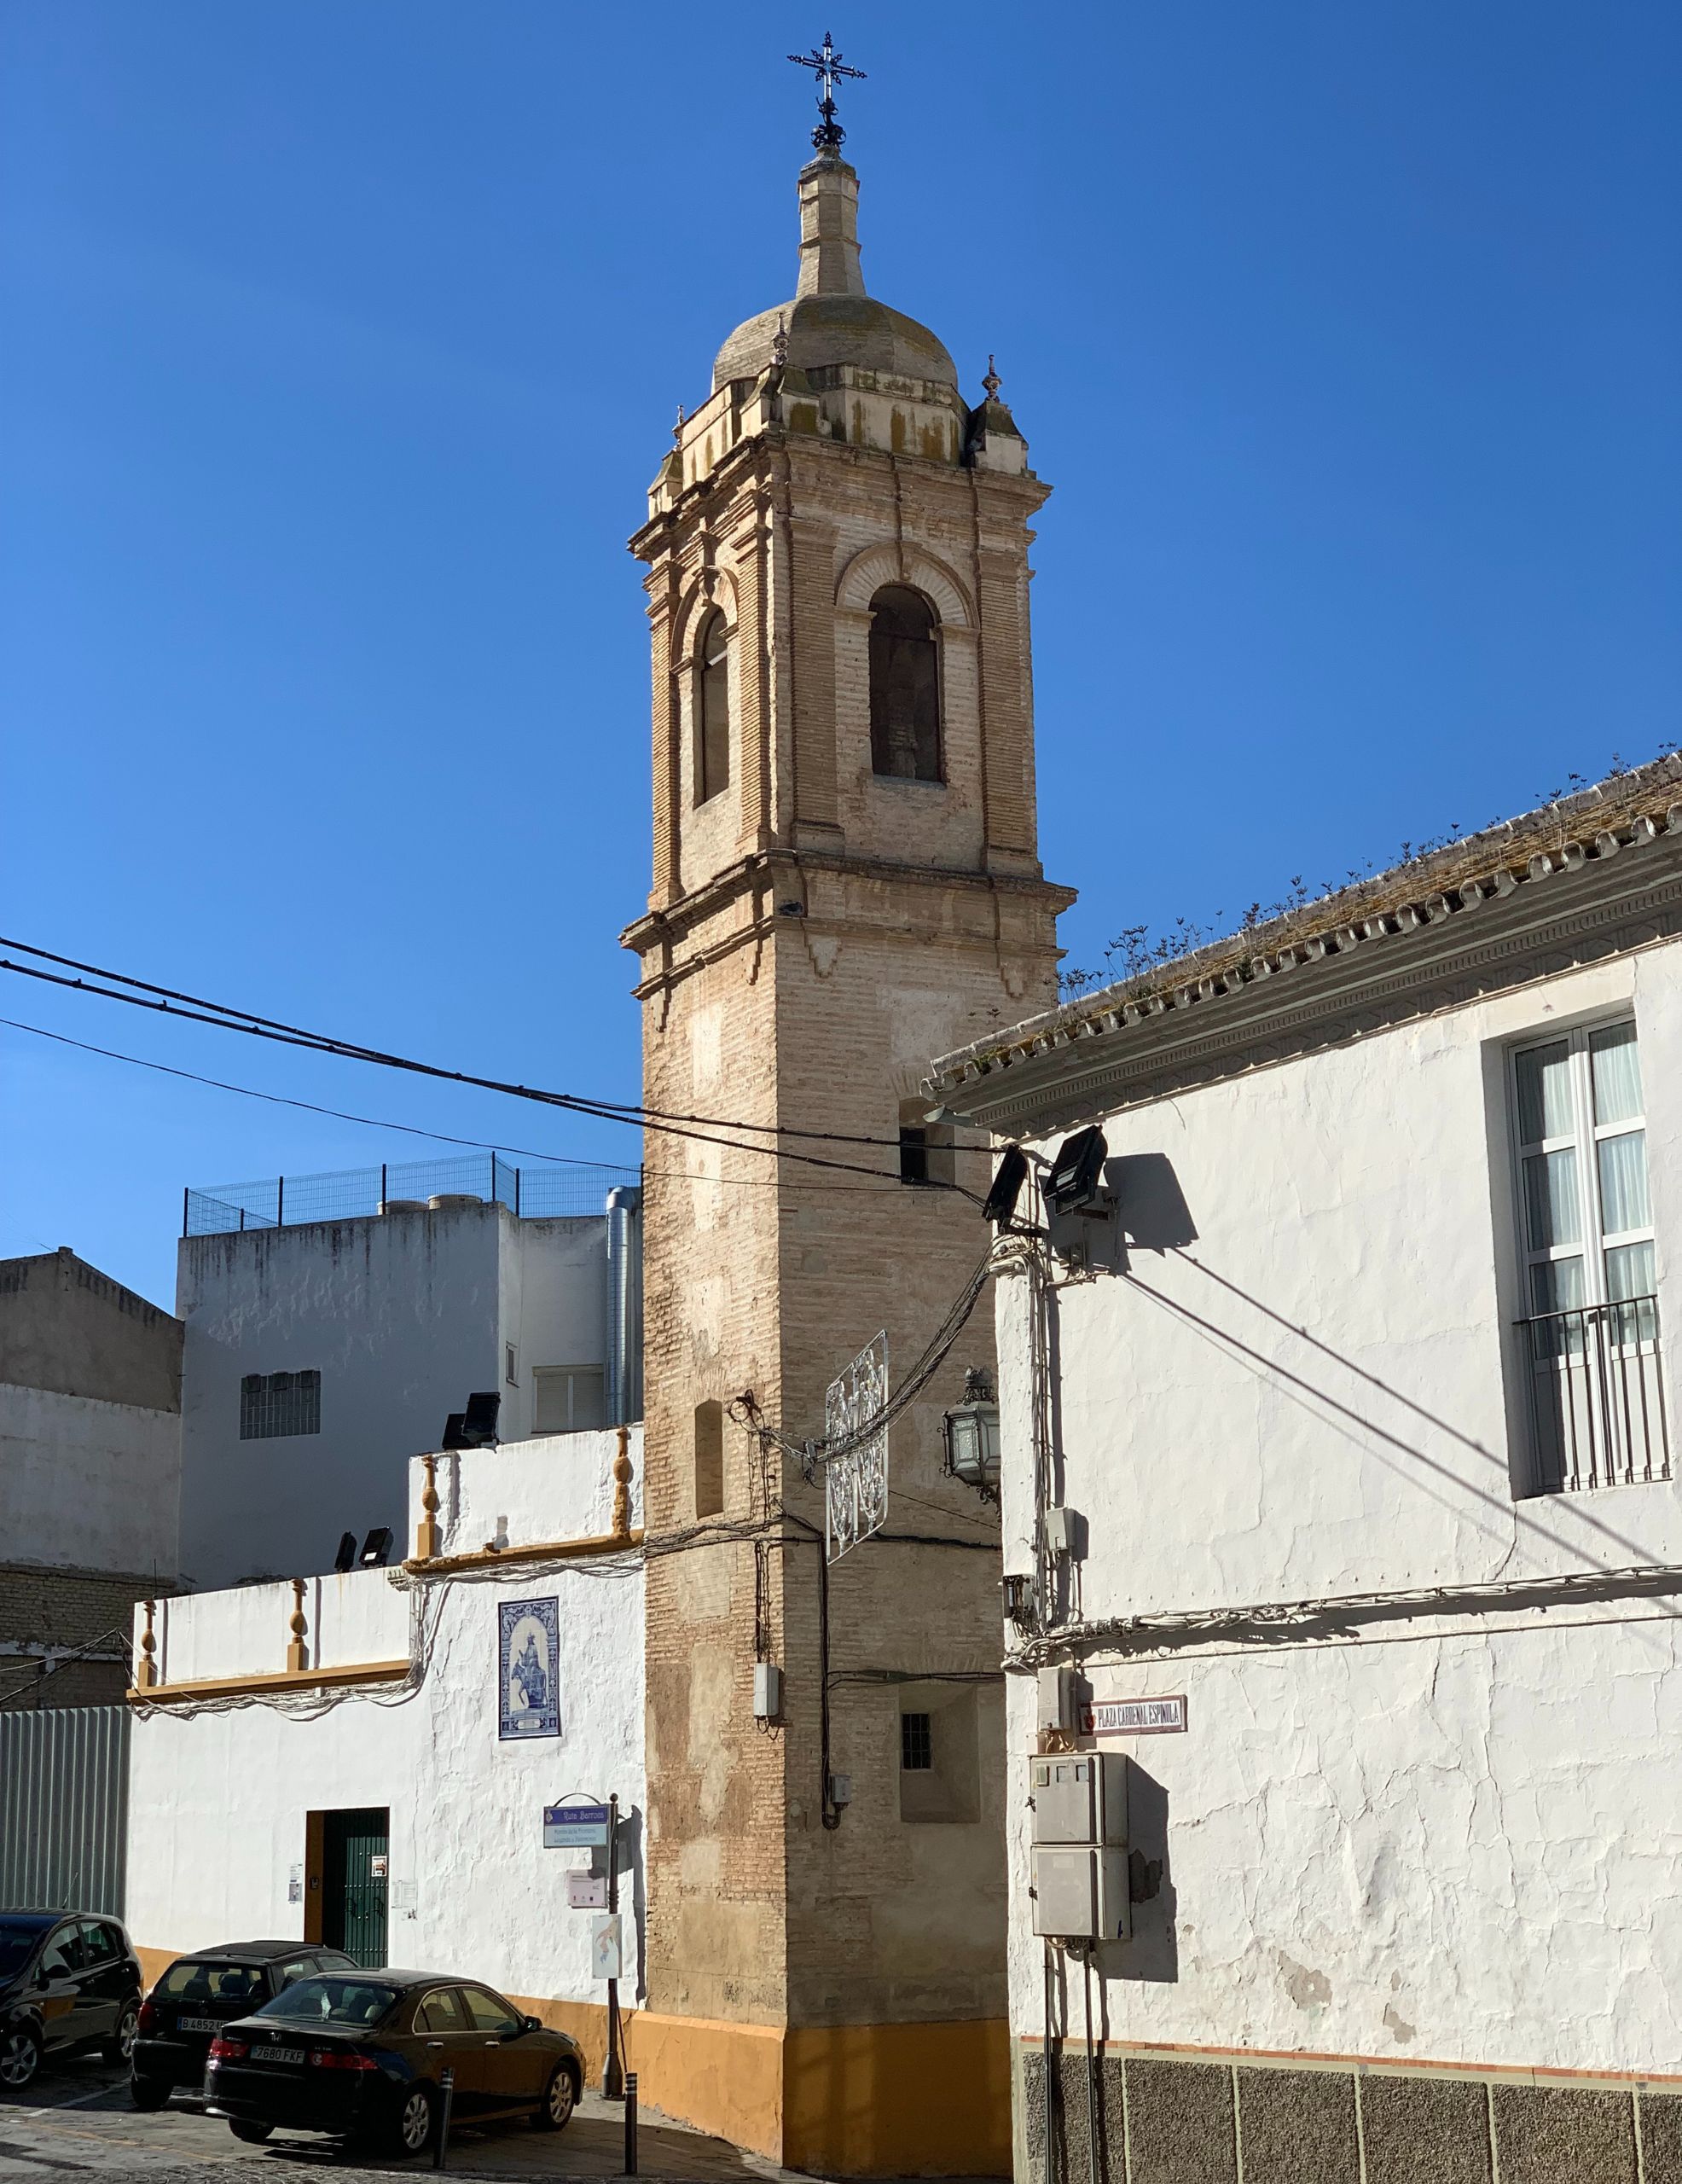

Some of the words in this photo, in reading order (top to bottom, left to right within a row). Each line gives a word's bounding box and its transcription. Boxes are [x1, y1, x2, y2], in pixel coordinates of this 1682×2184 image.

[1098, 1707, 1117, 1728] PLAZA
[1117, 1705, 1148, 1726] CARDENAL
[563, 1811, 577, 1821] Ruta
[190, 2019, 215, 2030] 4852
[258, 2047, 281, 2059] 7680
[283, 2049, 303, 2061] FKF
